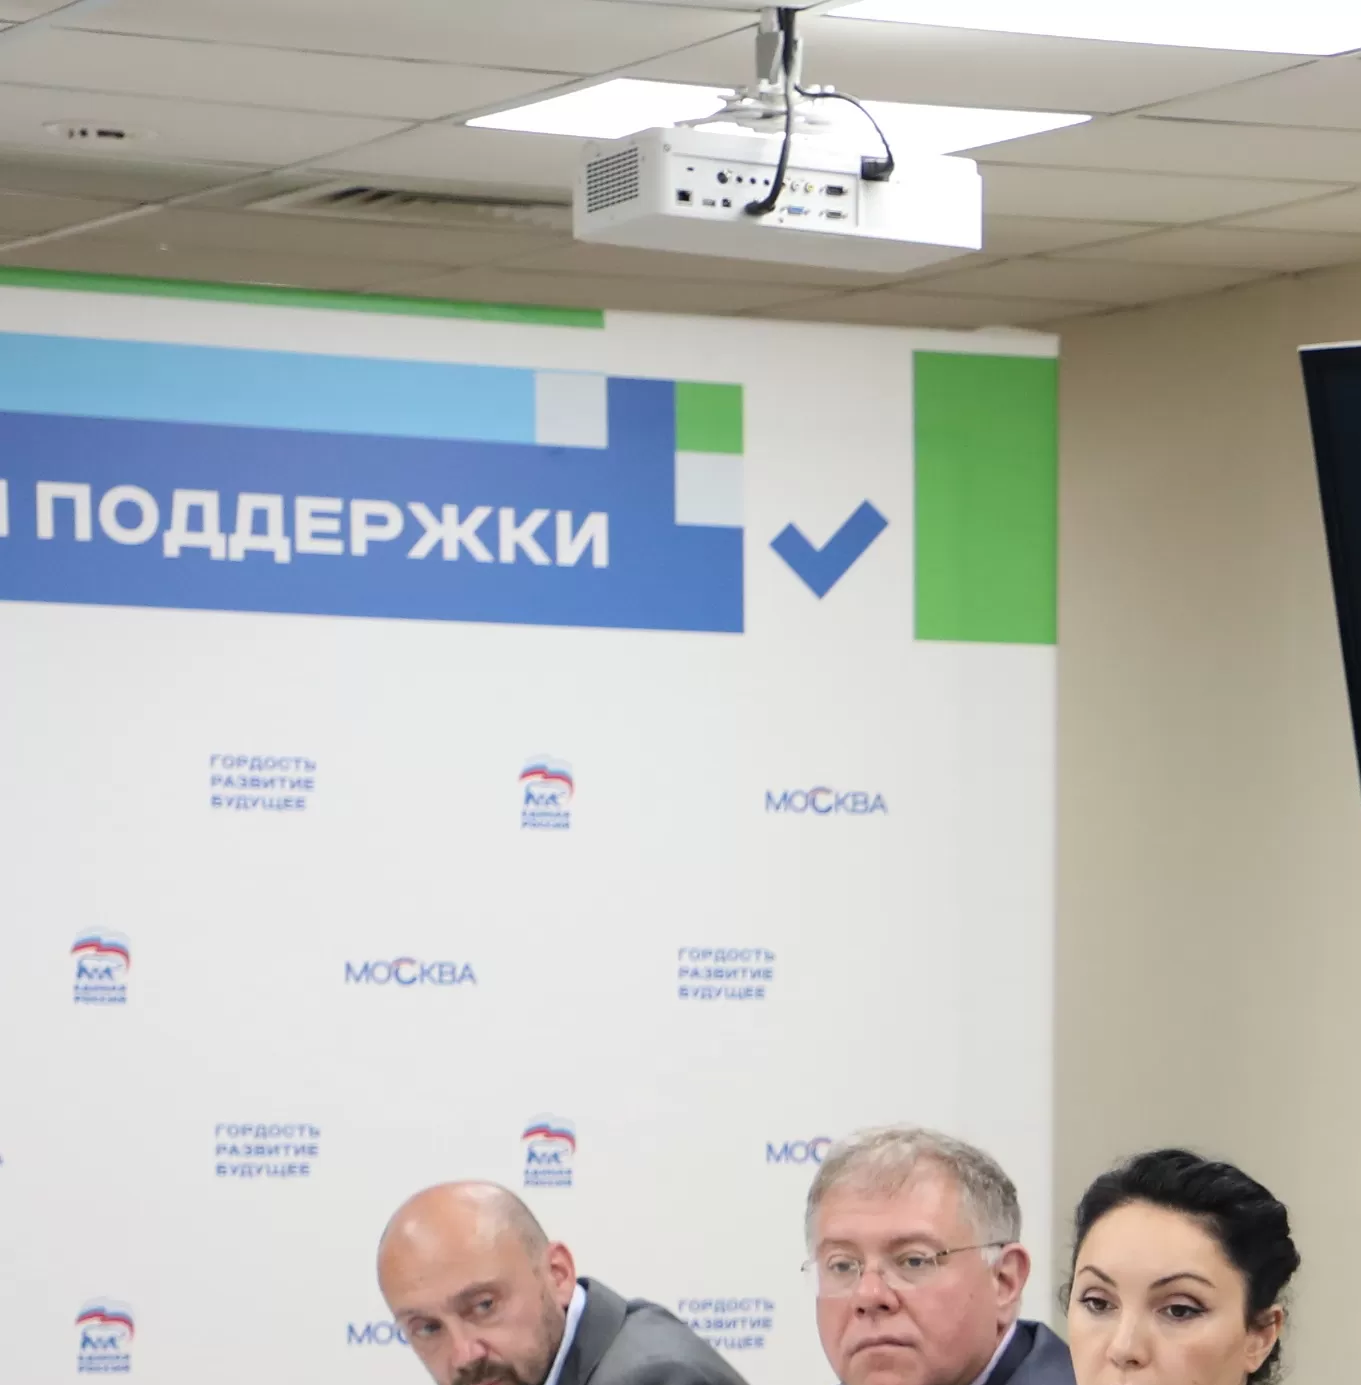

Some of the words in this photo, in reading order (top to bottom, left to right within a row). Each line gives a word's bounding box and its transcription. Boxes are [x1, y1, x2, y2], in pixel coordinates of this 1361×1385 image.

[35, 480, 610, 569] ПОДДЕРЖКИ
[764, 786, 889, 816] МОСКВА
[343, 956, 478, 986] МОСКВА
[766, 1136, 832, 1165] МОС
[346, 1320, 409, 1346] МО
[690, 1318, 773, 1330] АЗВИТИЕ
